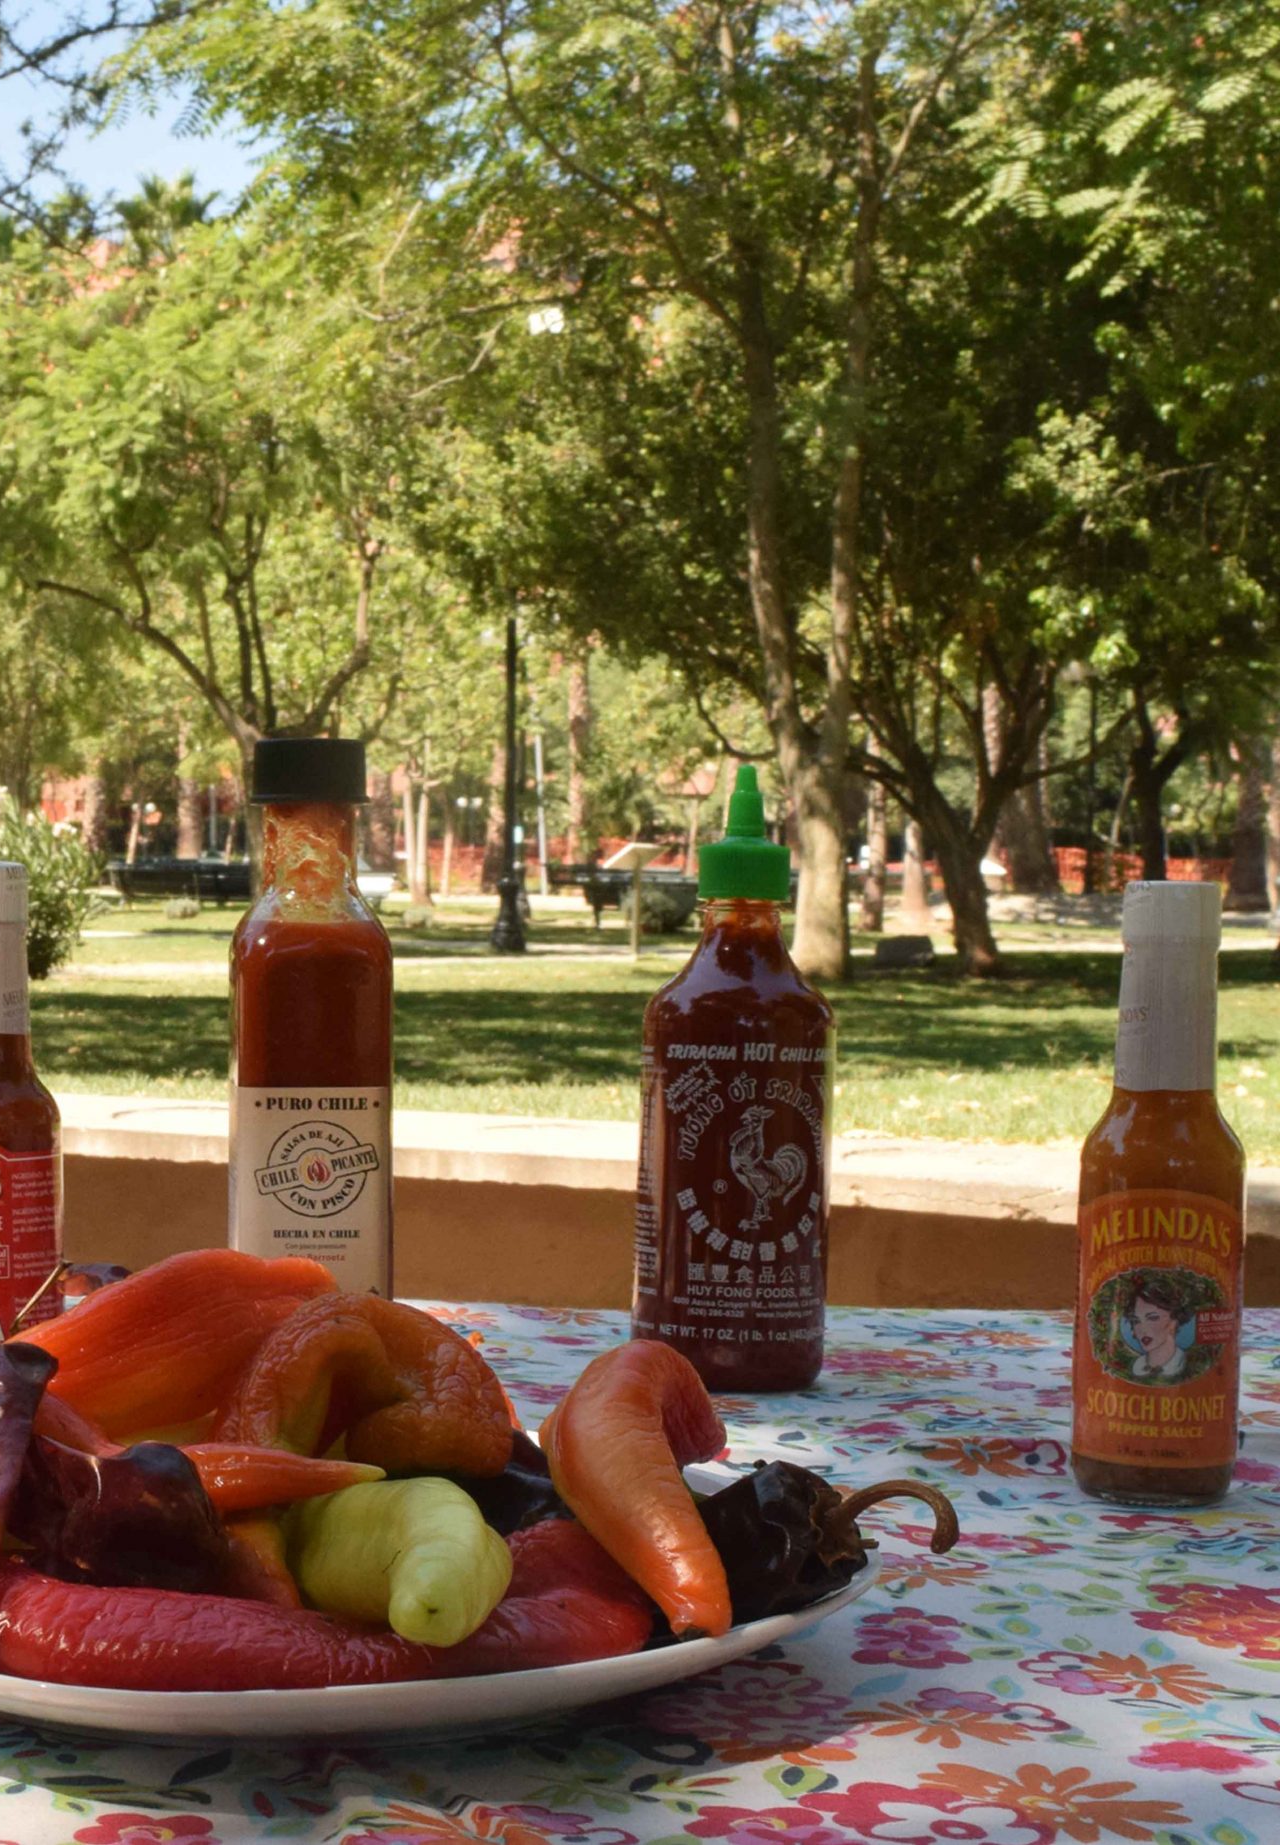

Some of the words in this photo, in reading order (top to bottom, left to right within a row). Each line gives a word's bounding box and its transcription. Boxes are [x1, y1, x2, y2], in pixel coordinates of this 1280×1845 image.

[667, 1044, 737, 1060] SRIRACHA
[743, 1043, 776, 1062] HOT
[779, 1047, 813, 1062] CHILI
[266, 1097, 312, 1111] PURO
[317, 1097, 368, 1110] CHILE
[281, 1134, 307, 1161] SALSA
[309, 1130, 323, 1139] DE
[261, 1167, 299, 1188] CHILE
[331, 1151, 376, 1172] PICANTE
[290, 1190, 317, 1210] CON
[321, 1178, 355, 1210] PISCO
[273, 1229, 309, 1239] HECHA
[312, 1229, 326, 1239] EN
[329, 1229, 360, 1239] CHILE
[1090, 1207, 1232, 1257] MELINDA'S
[687, 1285, 712, 1296] HUY
[716, 1286, 752, 1298] FONG
[659, 1324, 678, 1336] NET
[703, 1327, 715, 1339] 17
[1086, 1387, 1156, 1420] SCOTCH
[1160, 1395, 1225, 1423] BONNET
[1108, 1422, 1159, 1438] PEPPER
[1162, 1426, 1203, 1438] SAUCE
